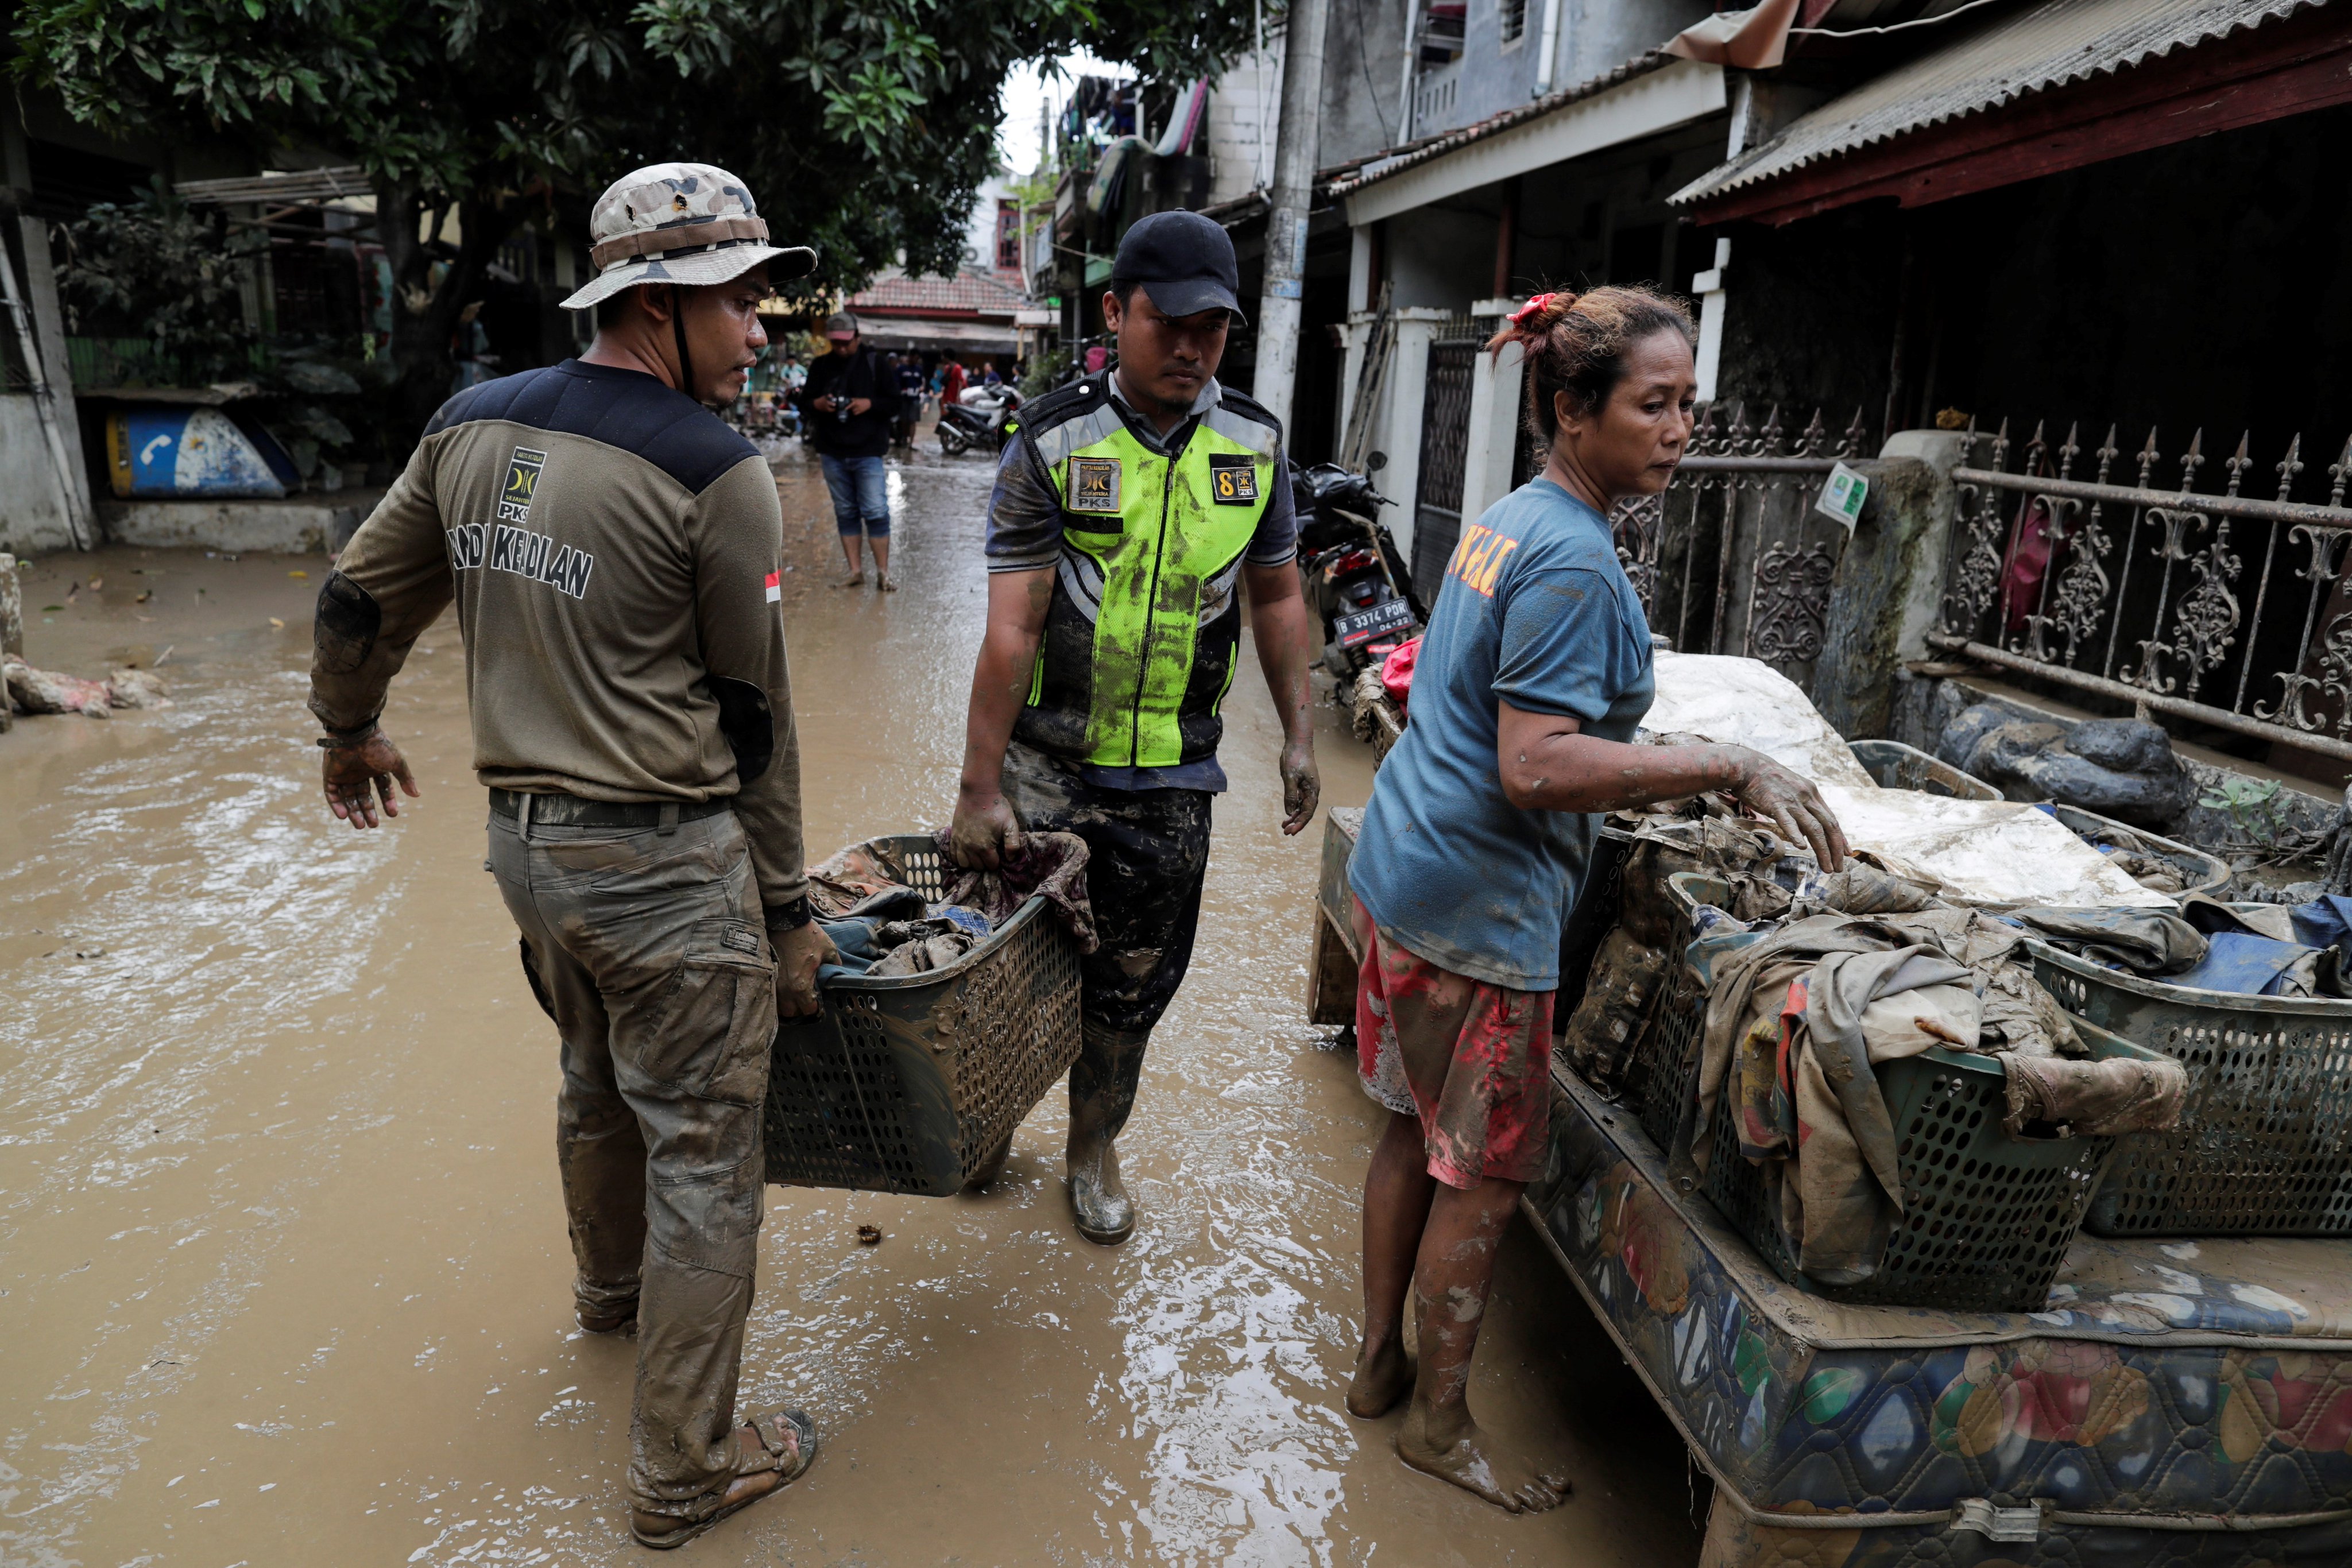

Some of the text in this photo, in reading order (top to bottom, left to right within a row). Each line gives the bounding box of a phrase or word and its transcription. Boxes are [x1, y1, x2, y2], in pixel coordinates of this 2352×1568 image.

[1218, 471, 1234, 496] 8
[498, 503, 528, 522] PKS
[1078, 498, 1111, 508] PKS
[1339, 622, 1348, 633] B
[1354, 611, 1382, 629] 3374
